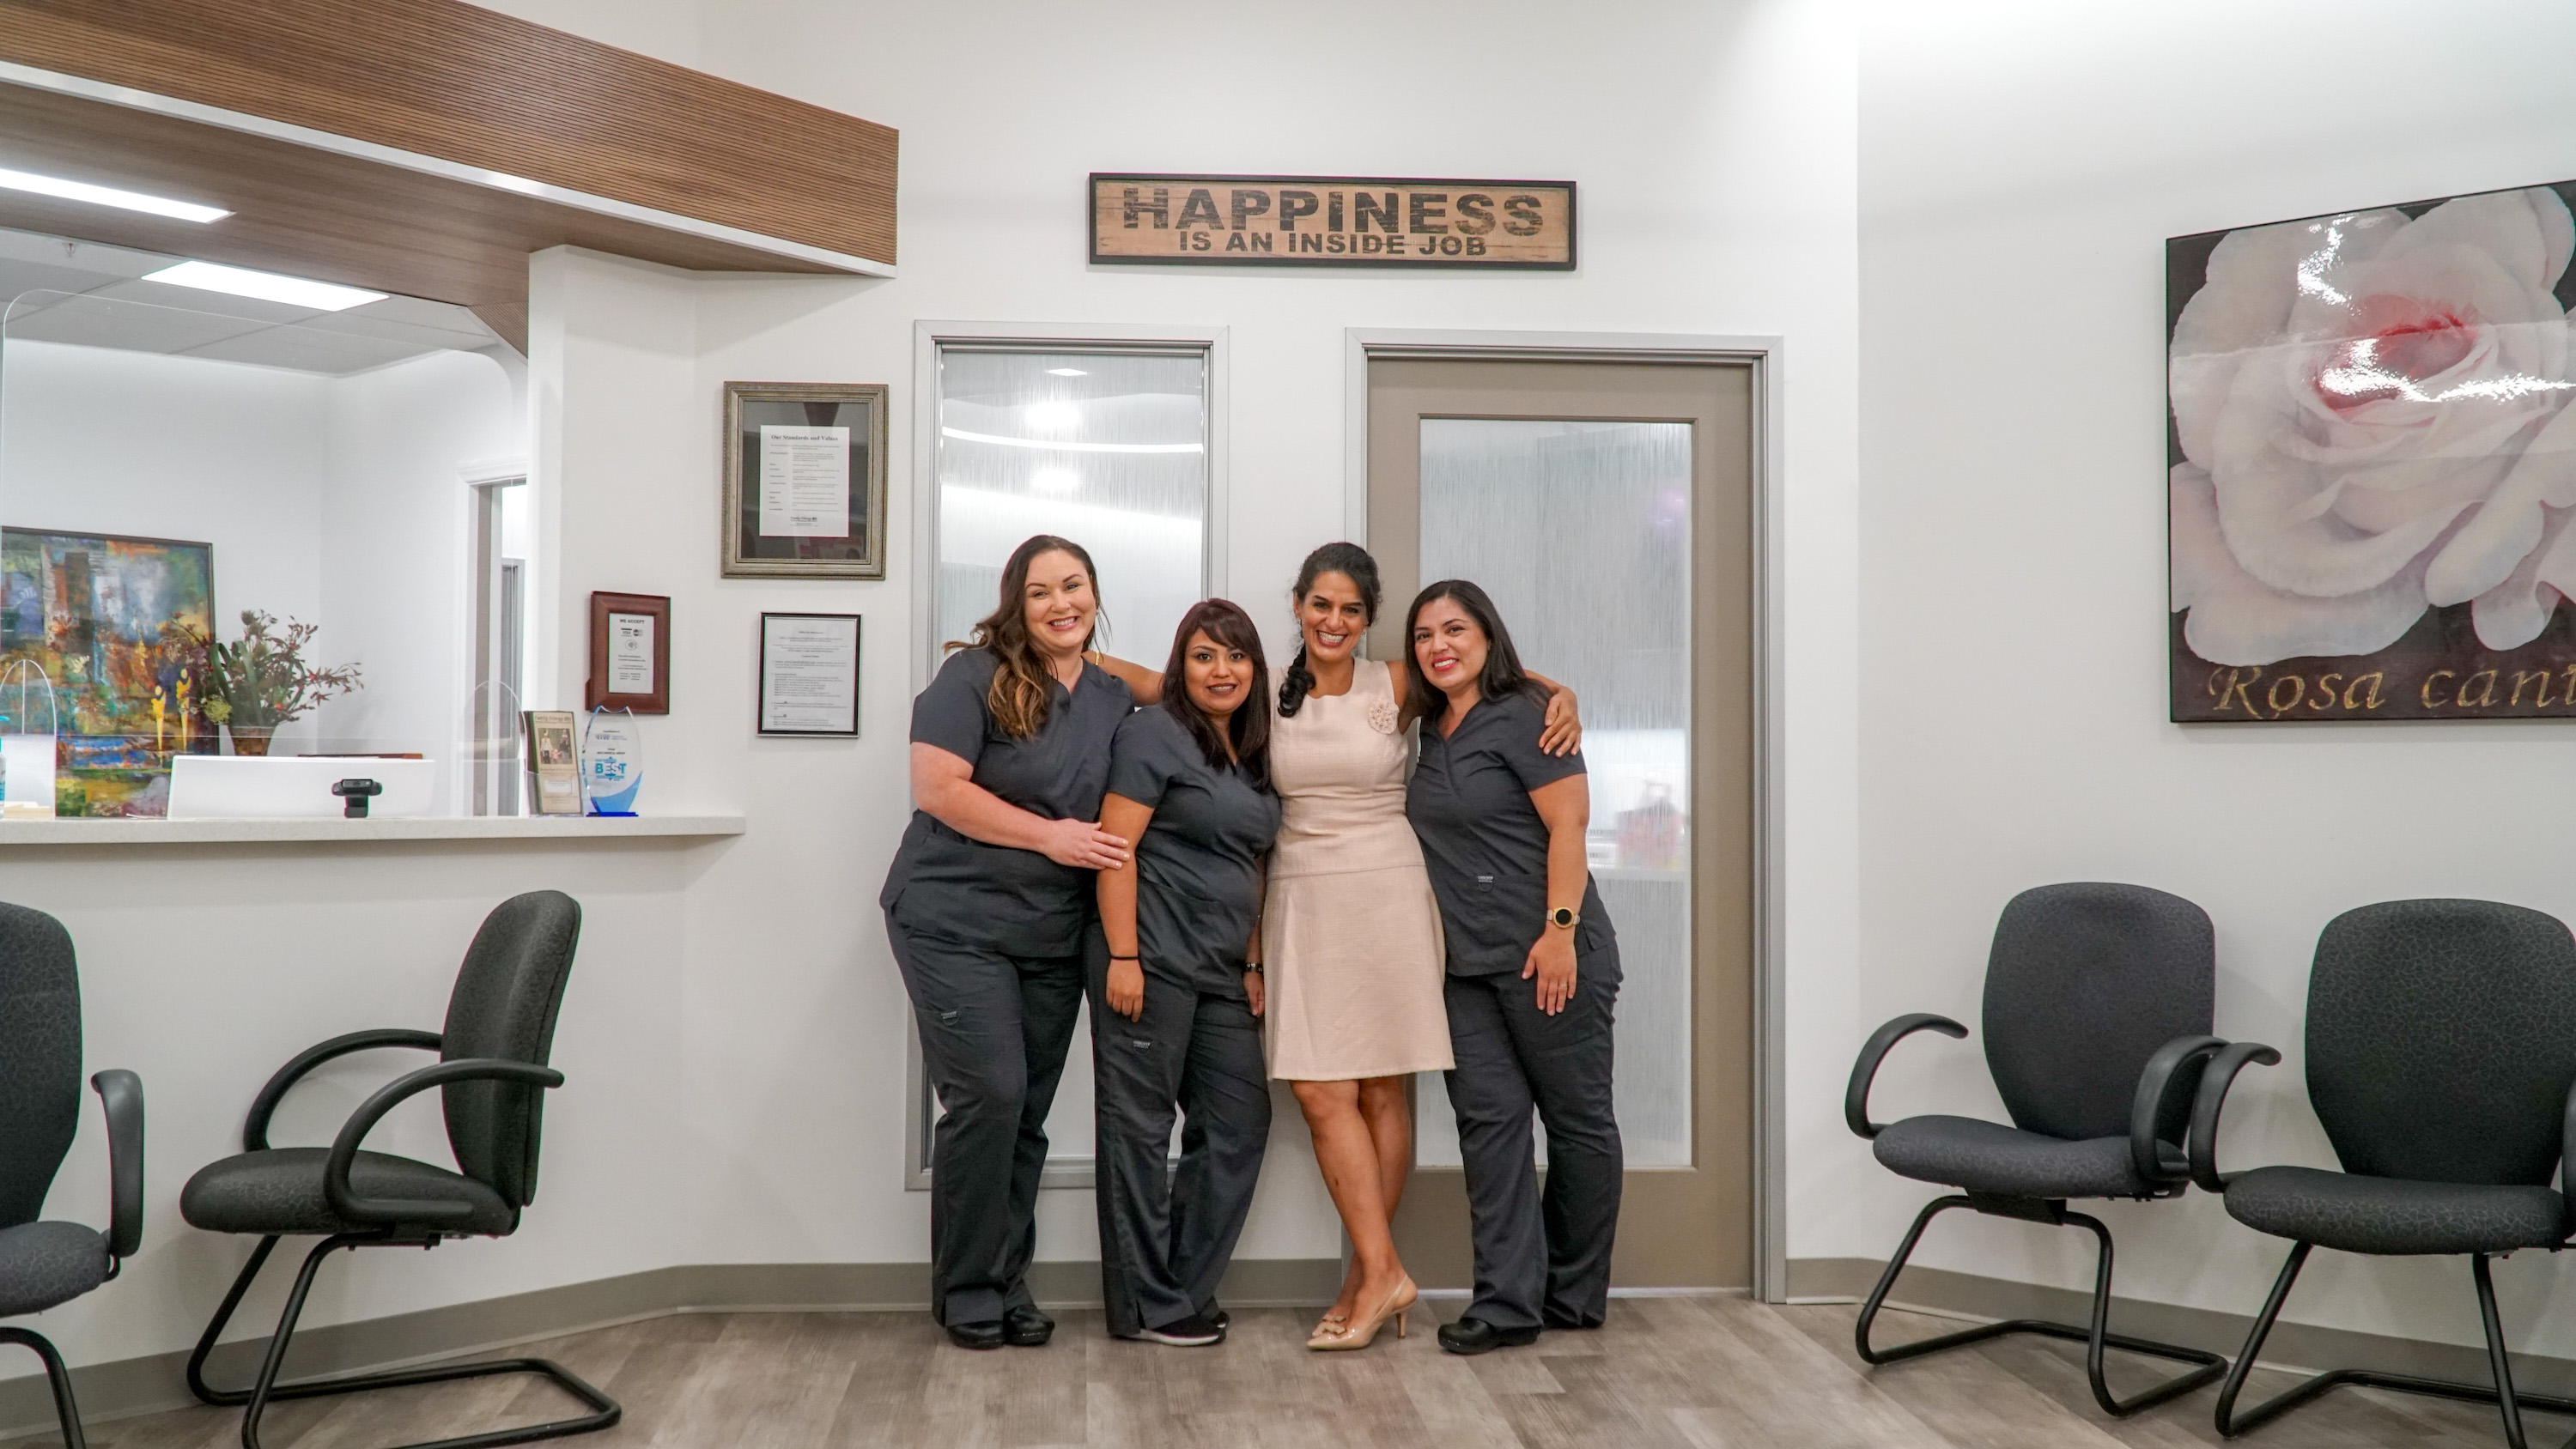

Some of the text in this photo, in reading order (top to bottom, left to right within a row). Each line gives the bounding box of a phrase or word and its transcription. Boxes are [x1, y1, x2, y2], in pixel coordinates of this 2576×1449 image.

[1123, 187, 1544, 237] HAPPINESS
[1179, 231, 1487, 257] IS AN INSIDE JOB
[2208, 665, 2386, 720] Rosa
[595, 762, 627, 774] BEST
